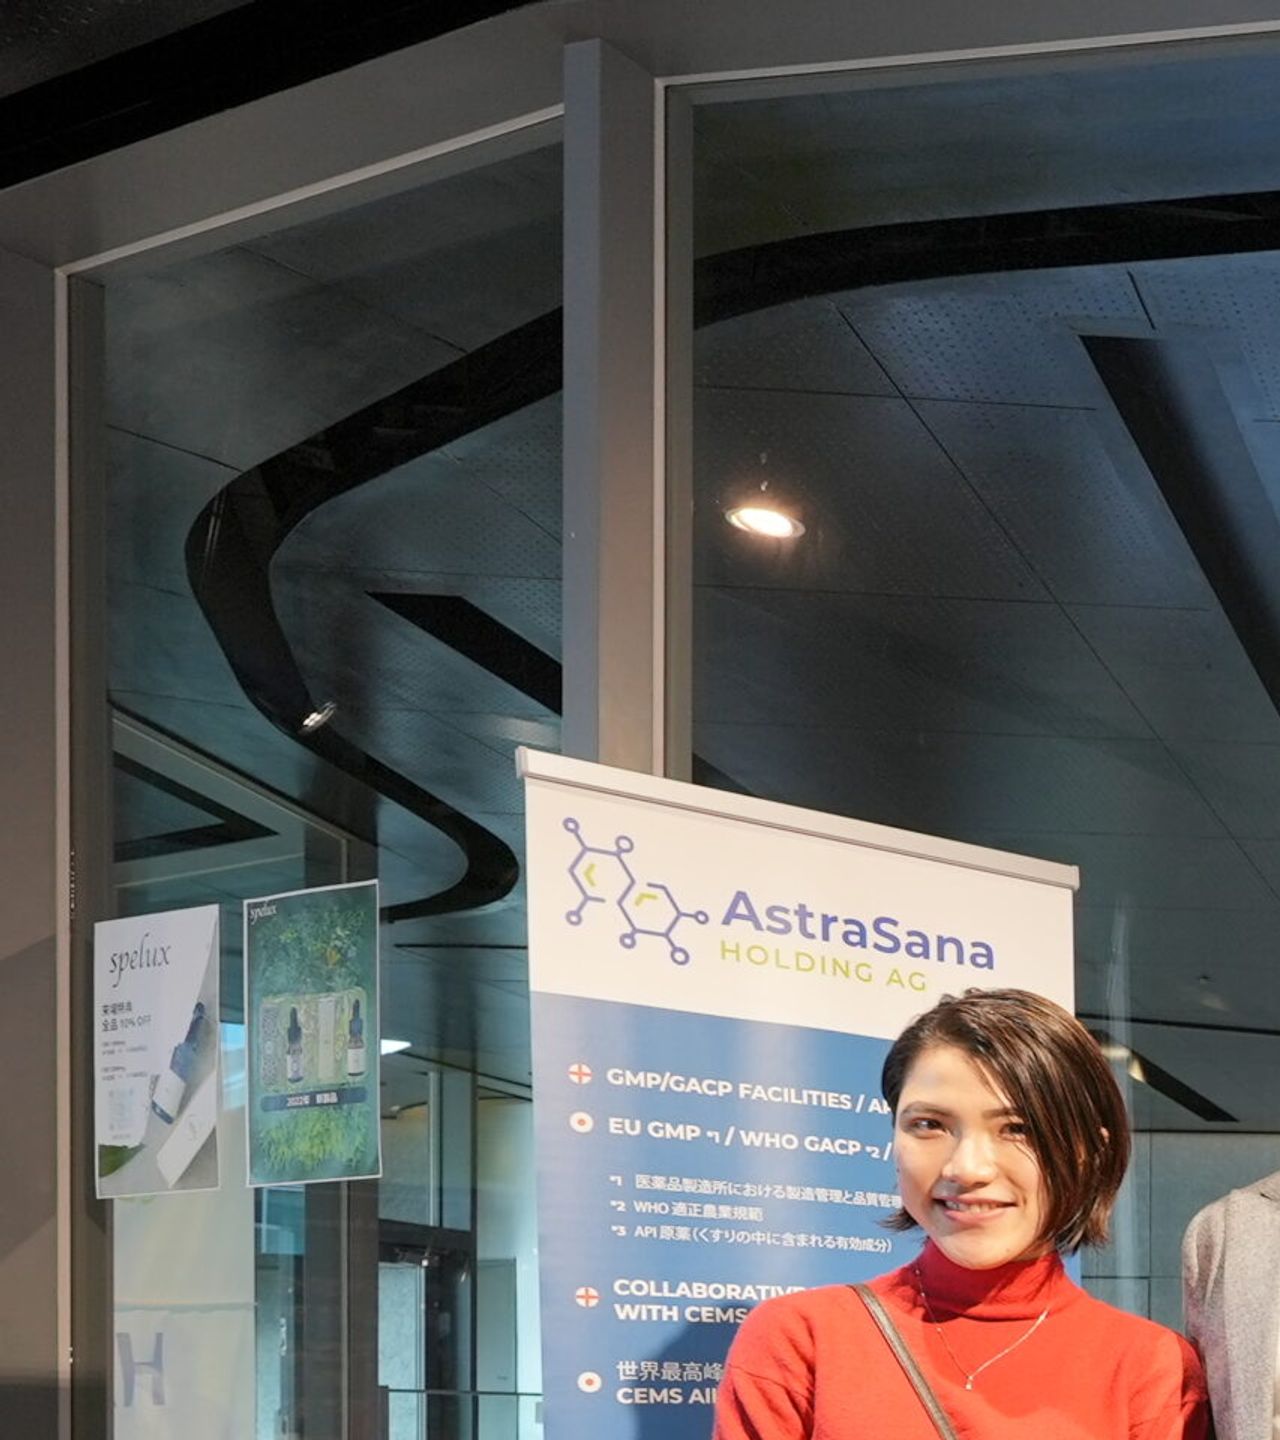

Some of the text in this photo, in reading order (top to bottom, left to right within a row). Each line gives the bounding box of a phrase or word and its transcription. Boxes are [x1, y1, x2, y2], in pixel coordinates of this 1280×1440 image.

[721, 891, 995, 970] AstraSana
[109, 932, 172, 988] spelux
[720, 941, 928, 992] HOLDING AG
[606, 1068, 733, 1097] GMP/GACP
[739, 1083, 852, 1110] FACILITIES
[608, 1117, 641, 1136] EU
[647, 1121, 700, 1141] GMP
[739, 1130, 799, 1150] WHO
[804, 1135, 861, 1156] GACP
[633, 1201, 669, 1215] WHO
[635, 1174, 903, 1209] 医薬品製造所における製造管理と品質管理
[633, 1225, 658, 1239] API
[613, 1303, 750, 1324] WITH CEMS
[616, 1360, 724, 1383] 世界最高峰
[616, 1387, 684, 1404] CEMS
